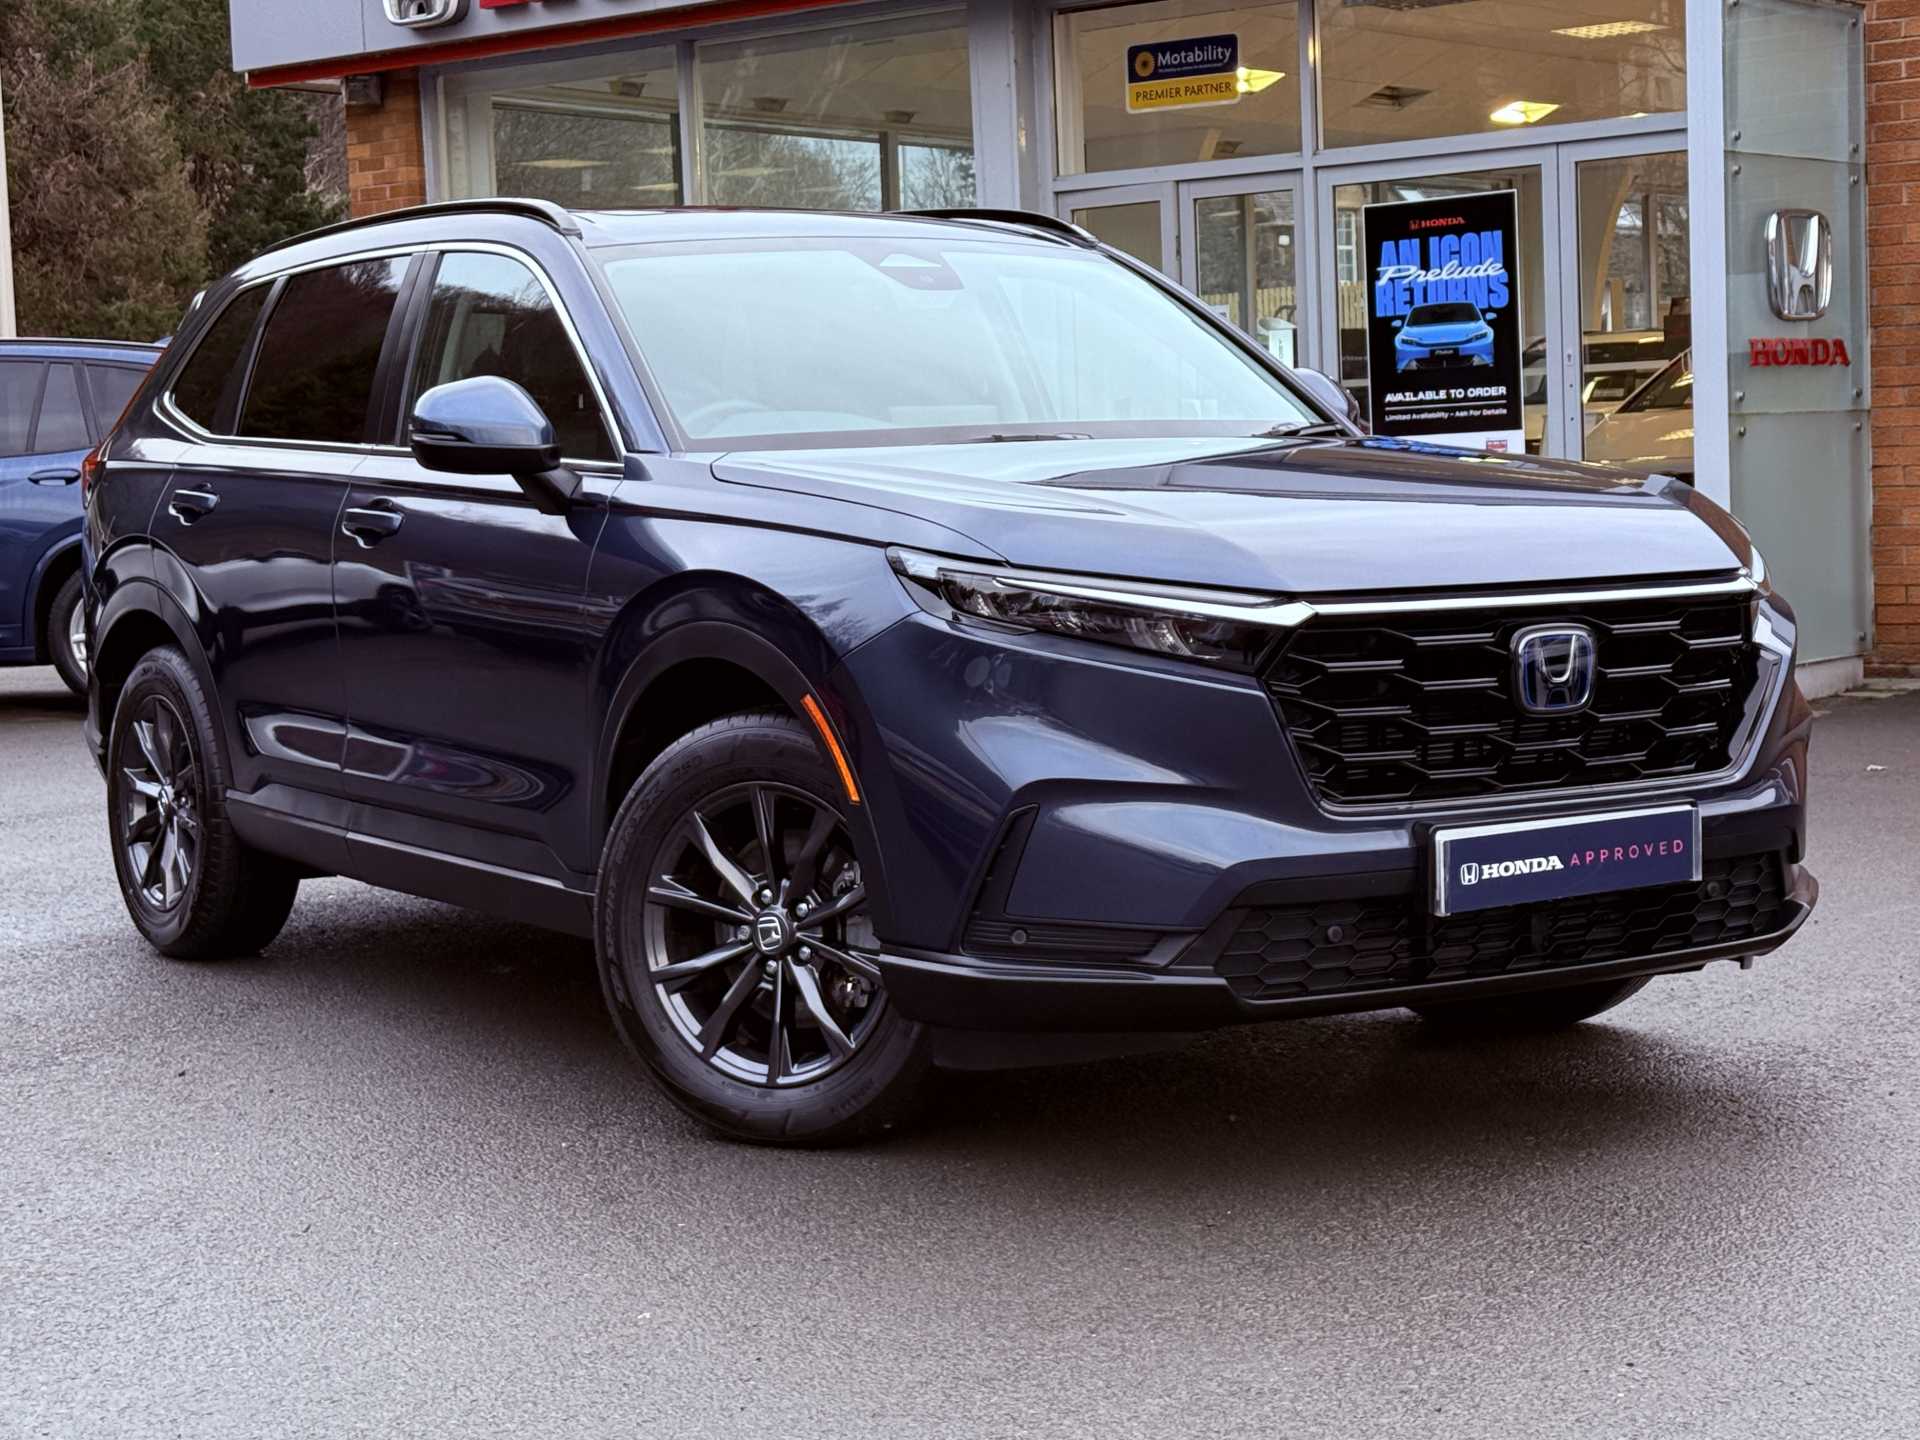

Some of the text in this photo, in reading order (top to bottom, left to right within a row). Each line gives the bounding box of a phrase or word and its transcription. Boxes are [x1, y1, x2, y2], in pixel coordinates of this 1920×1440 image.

[1157, 45, 1232, 67] Motability
[1135, 82, 1232, 102] PREMIER PARTNER
[1421, 216, 1465, 228] HONDA
[1380, 230, 1504, 274] AN ICON
[1376, 257, 1506, 287] Prelude
[1375, 272, 1509, 317] RETURNS
[1749, 337, 1850, 367] HONDA
[1385, 386, 1507, 403] AVAILABLE TO ORDER
[1385, 413, 1411, 422] Limited
[1481, 839, 1685, 880] HONDA APPROVED
